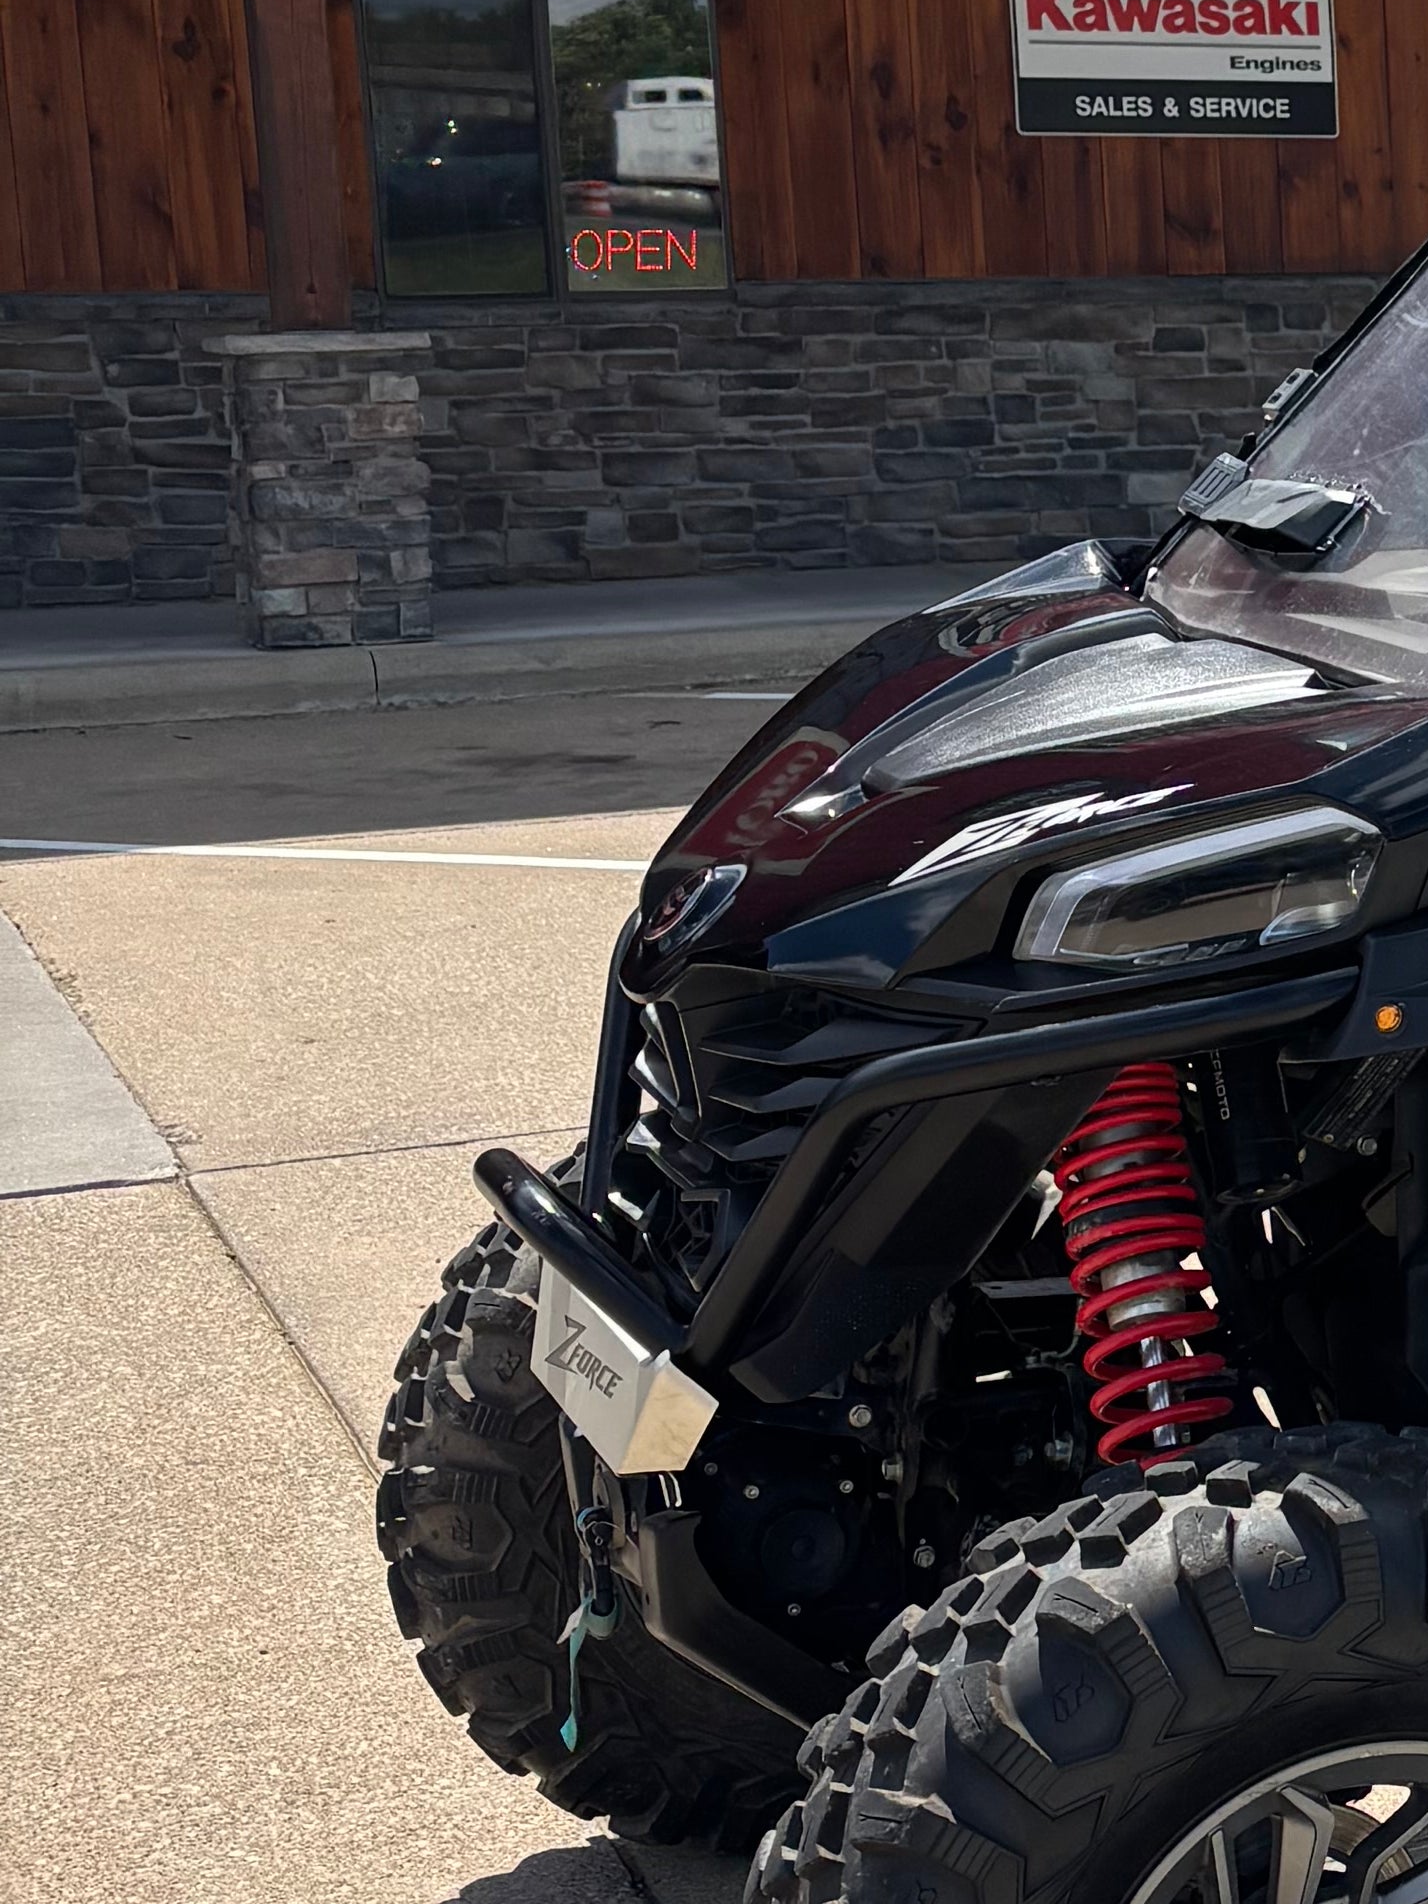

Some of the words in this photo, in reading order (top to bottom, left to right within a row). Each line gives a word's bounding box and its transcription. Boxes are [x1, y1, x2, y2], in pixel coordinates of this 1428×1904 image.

[1230, 55, 1322, 73] Engines
[1075, 95, 1153, 117] SALES
[1163, 98, 1179, 117] &
[1189, 98, 1290, 119] SERVICE
[572, 229, 697, 272] OPEN
[544, 1314, 624, 1399] ZFORCE
